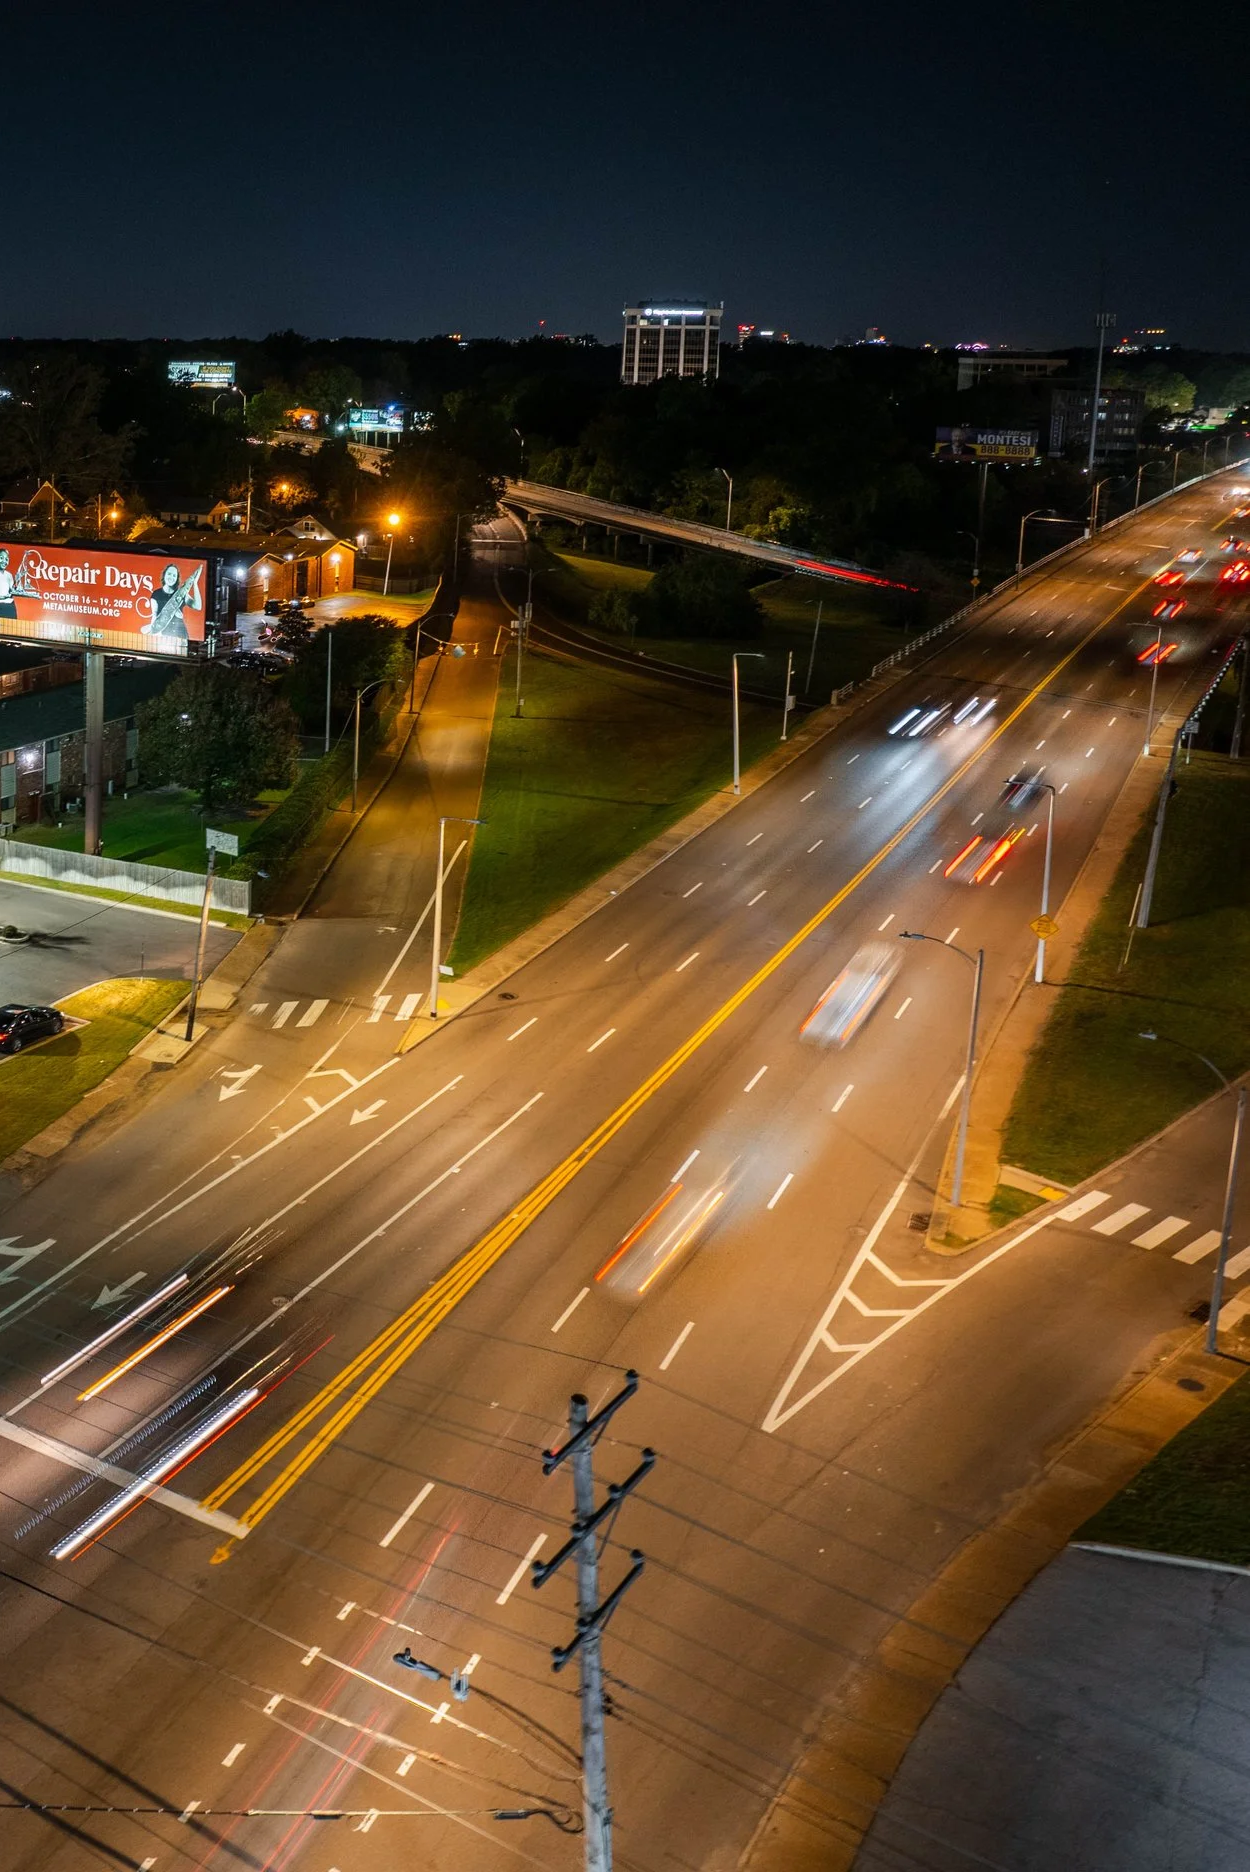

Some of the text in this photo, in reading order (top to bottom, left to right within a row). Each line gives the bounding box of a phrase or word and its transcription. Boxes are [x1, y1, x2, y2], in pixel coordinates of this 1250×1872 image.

[977, 434, 1031, 446] MONTESI
[981, 445, 1030, 456] 888-8888
[24, 550, 154, 597] Repair Days
[43, 592, 79, 603] OCTOBER
[81, 595, 91, 605] 16
[100, 597, 111, 608] 19,
[114, 599, 133, 609] 2025
[42, 602, 121, 617] METALMUSEUM.ORG
